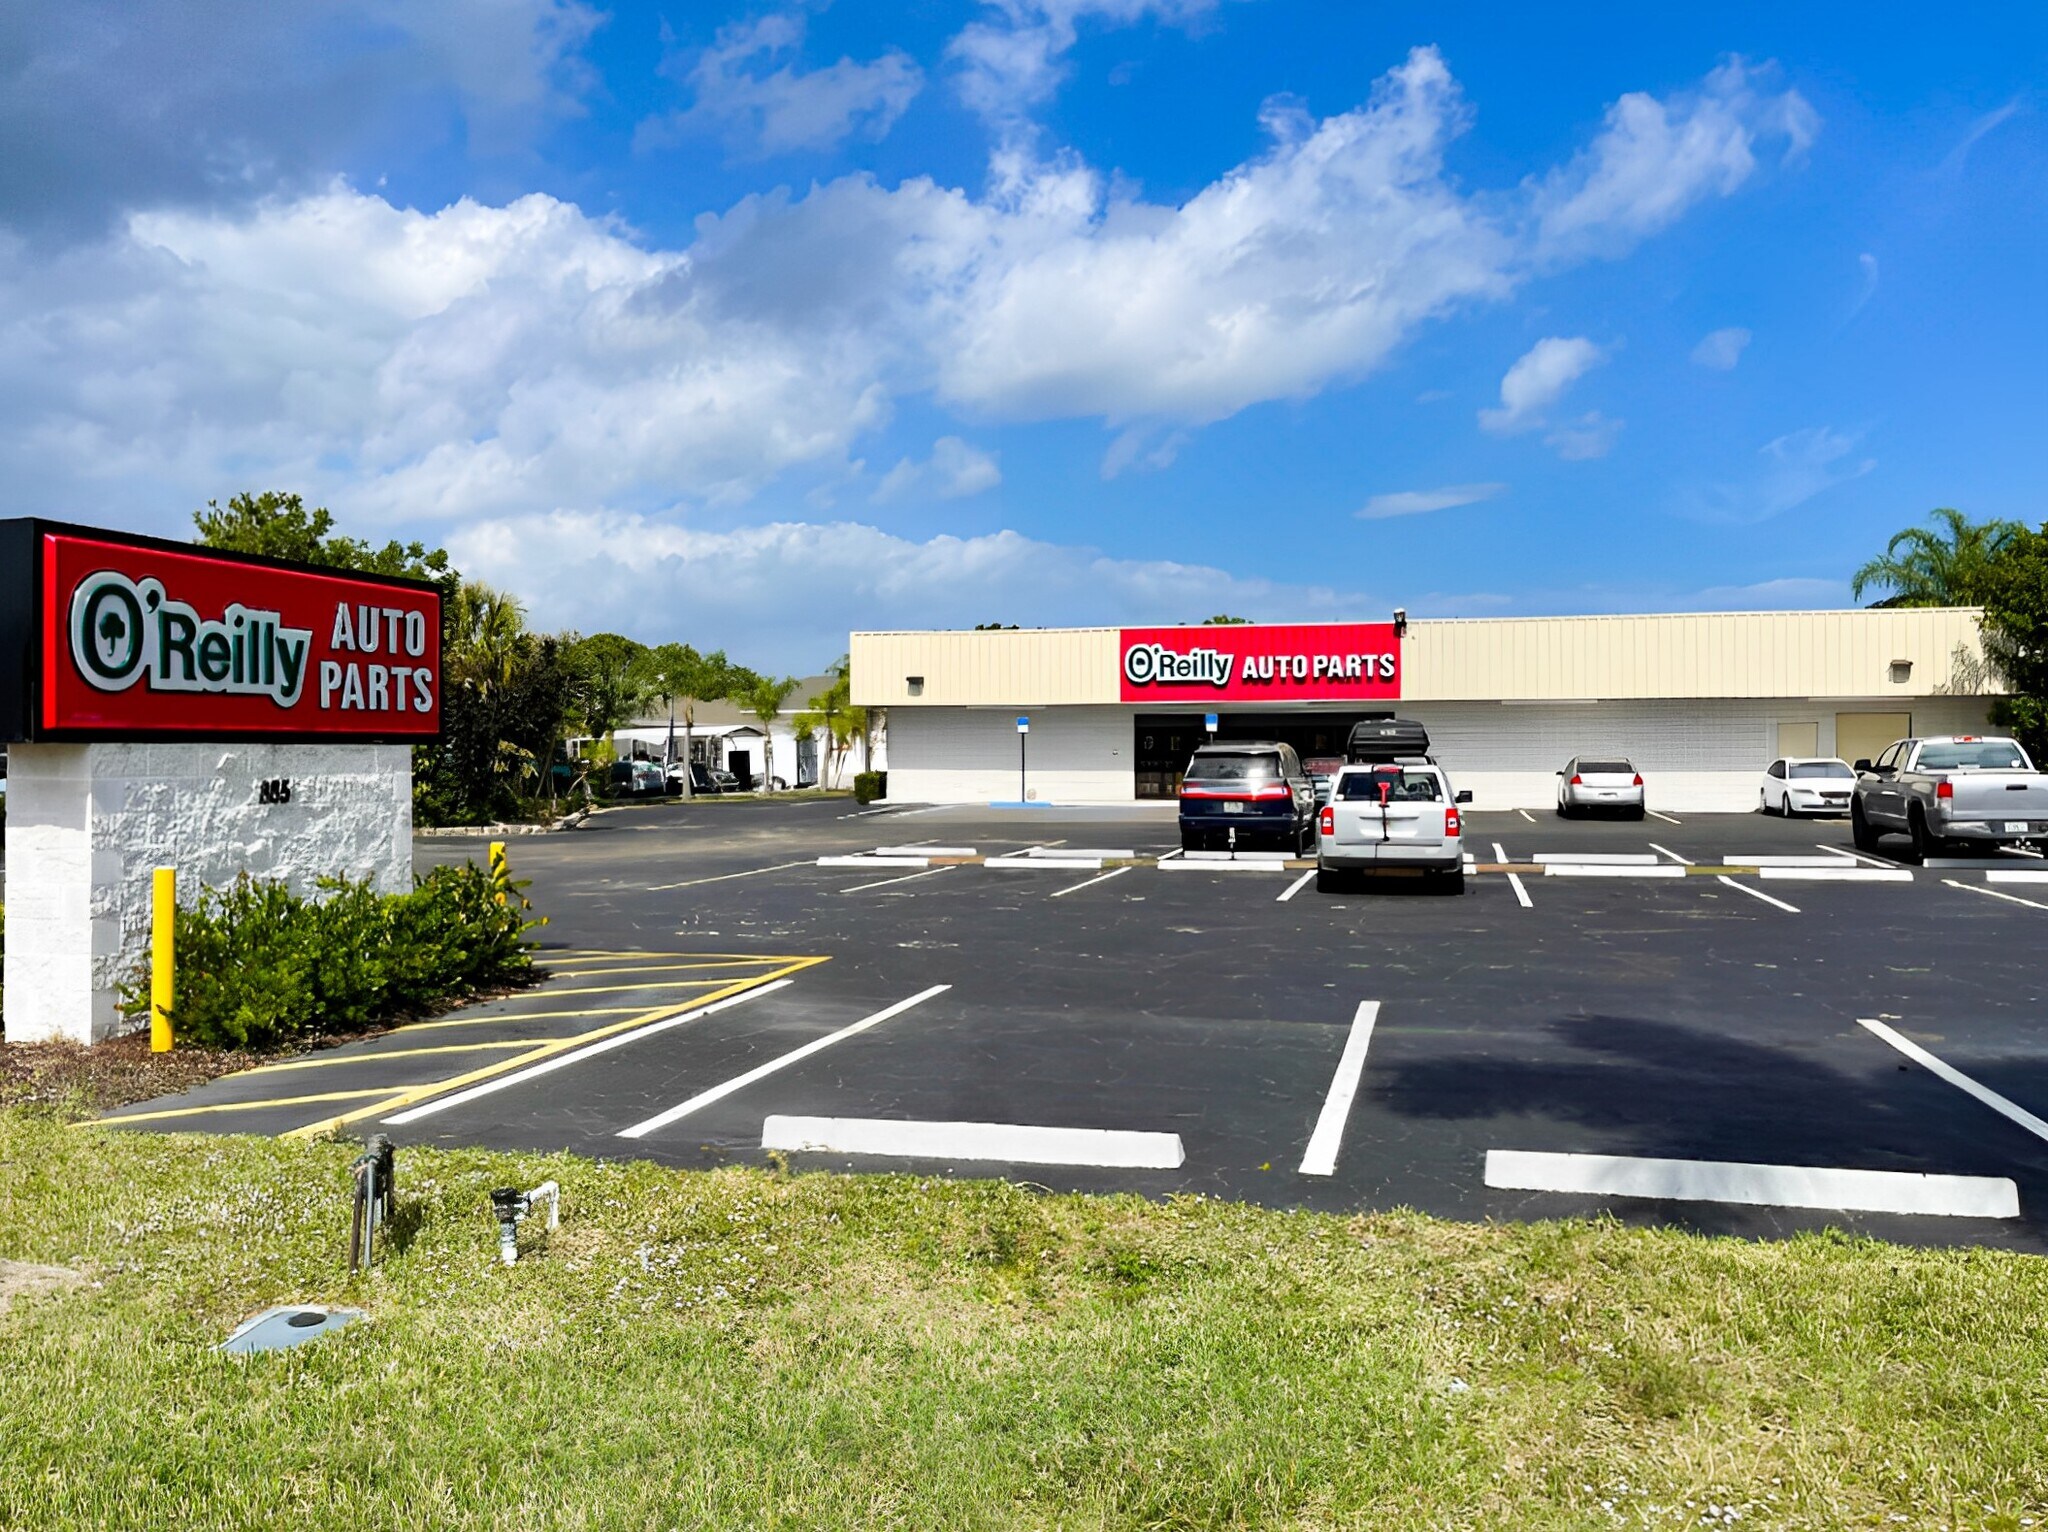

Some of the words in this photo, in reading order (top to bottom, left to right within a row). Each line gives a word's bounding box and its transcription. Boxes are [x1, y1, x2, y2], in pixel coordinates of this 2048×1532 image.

[78, 580, 308, 702] O'Reilly
[330, 602, 426, 658] AUTO
[319, 661, 433, 713] PARTS
[1126, 645, 1232, 683] O'Reilly
[1242, 655, 1308, 680] AUTO
[1312, 653, 1395, 678] PARTS
